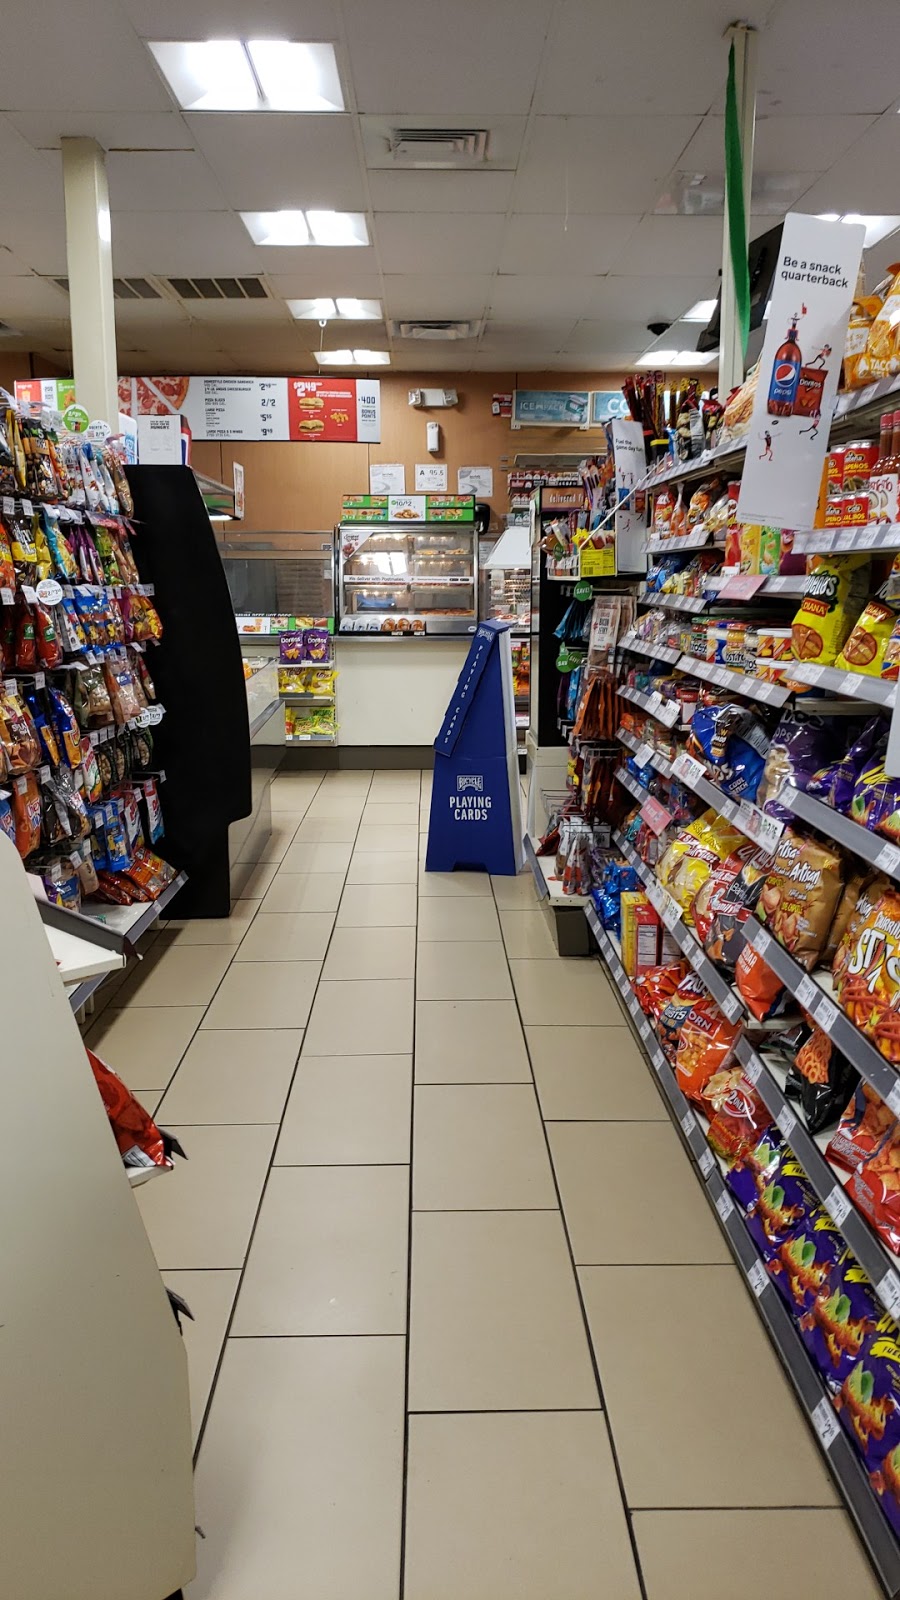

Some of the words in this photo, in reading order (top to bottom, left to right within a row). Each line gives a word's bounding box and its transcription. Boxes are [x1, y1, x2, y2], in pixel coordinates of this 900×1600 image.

[783, 256, 798, 268] Be
[800, 261, 807, 270] a
[809, 262, 842, 275] snack
[781, 270, 849, 288] quarterback
[800, 378, 821, 389] Doritos
[803, 601, 826, 615] DIANA
[460, 645, 484, 698] PLAYING
[443, 707, 460, 744] CARDS
[457, 775, 484, 792] BICYCLE
[450, 796, 492, 809] PLAYING
[454, 808, 488, 820] CARDS
[688, 1010, 712, 1032] ORN
